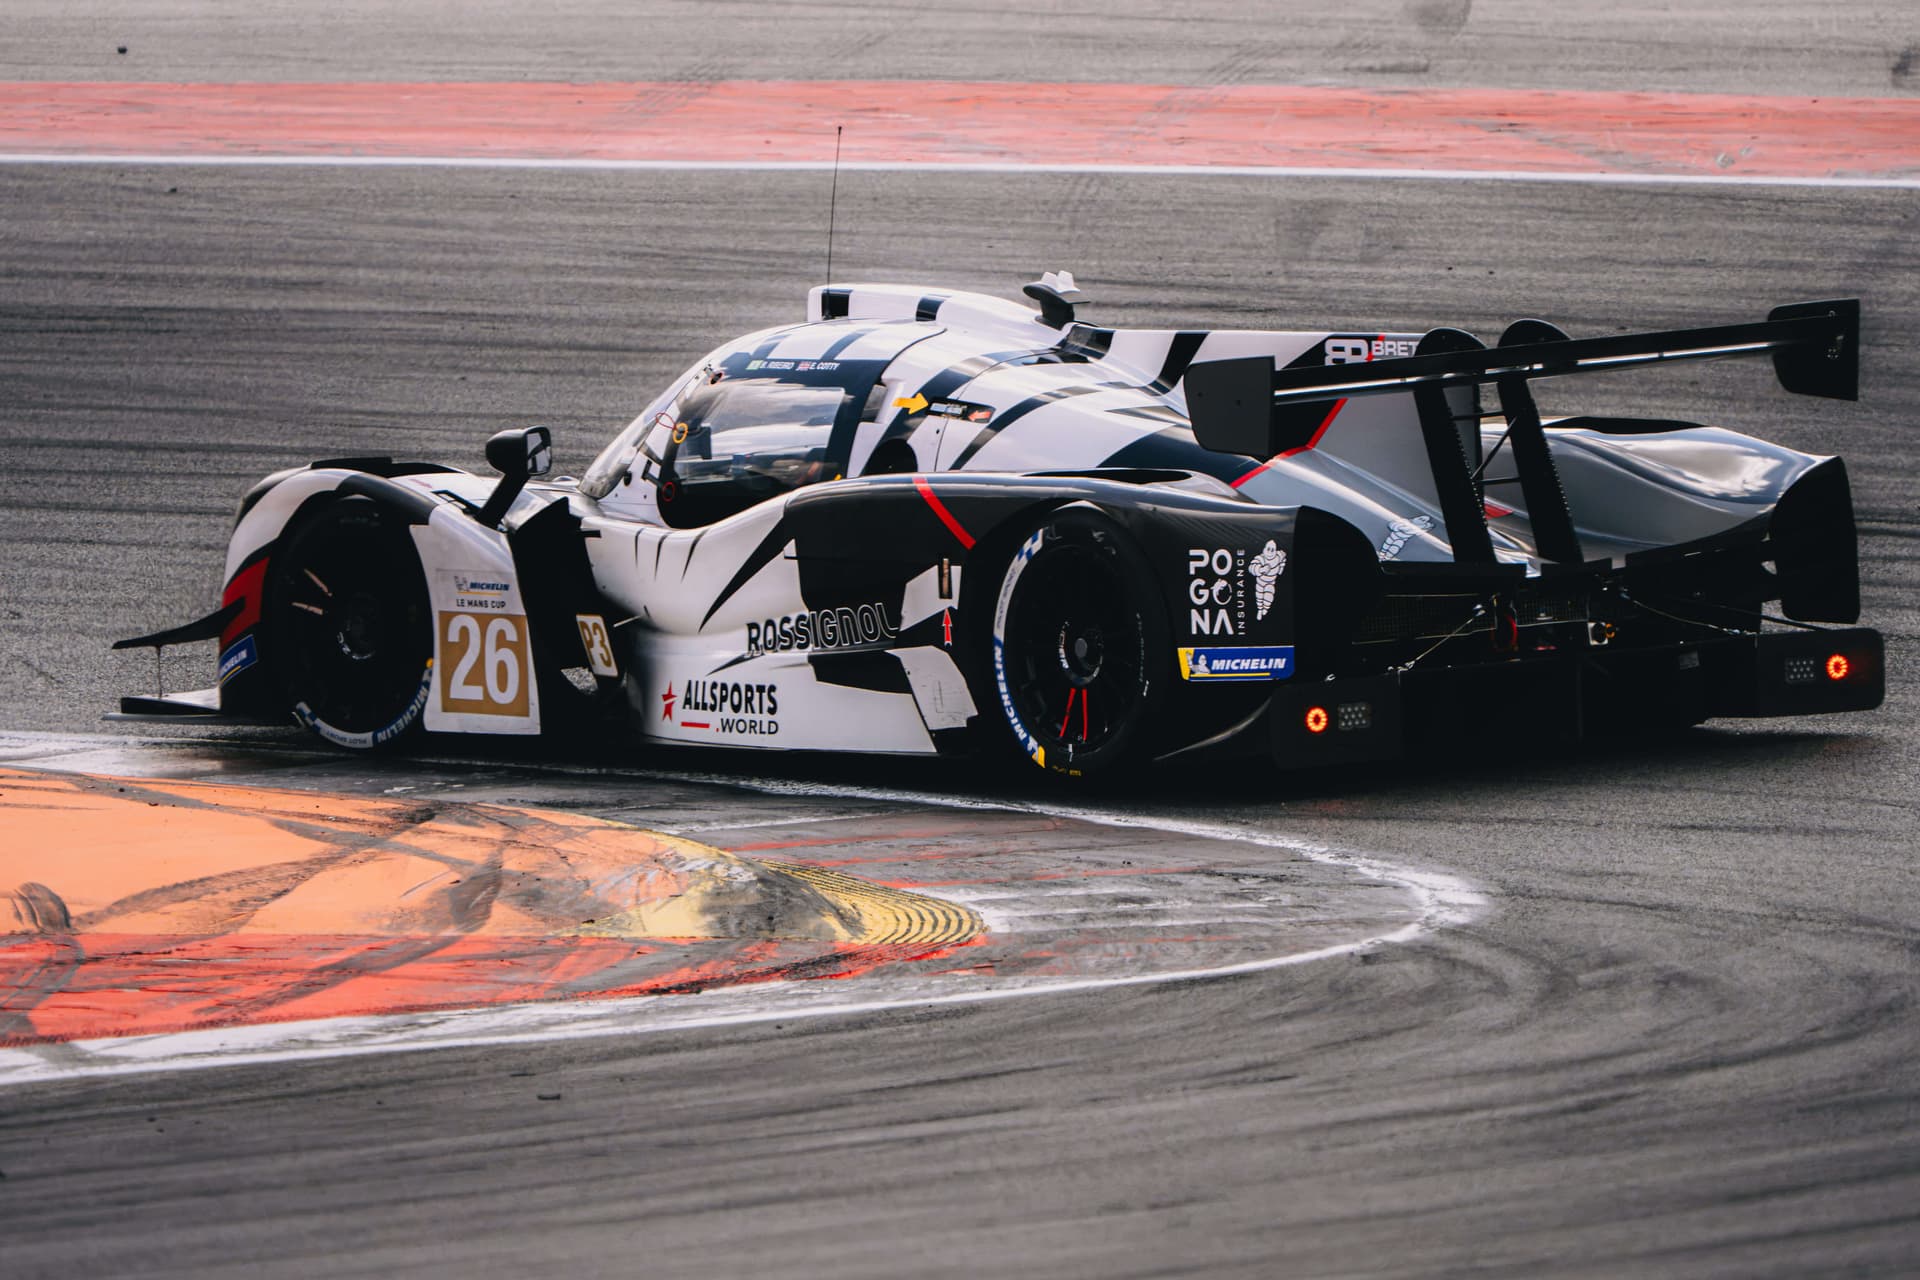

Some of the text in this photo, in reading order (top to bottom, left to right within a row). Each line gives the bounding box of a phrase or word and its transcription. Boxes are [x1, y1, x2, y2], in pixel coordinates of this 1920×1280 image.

[456, 598, 506, 609] LE MANS CUP
[470, 581, 510, 591] MICHELIN
[1236, 549, 1246, 636] INSURANCE
[578, 620, 613, 668] P3
[746, 603, 898, 656] ROSSIGNOL
[447, 613, 520, 705] 26
[1211, 657, 1287, 671] MICHELIN
[377, 685, 429, 744] MICHELIN
[682, 679, 778, 716] ALLSPORTS
[994, 645, 1028, 741] MICHELIN
